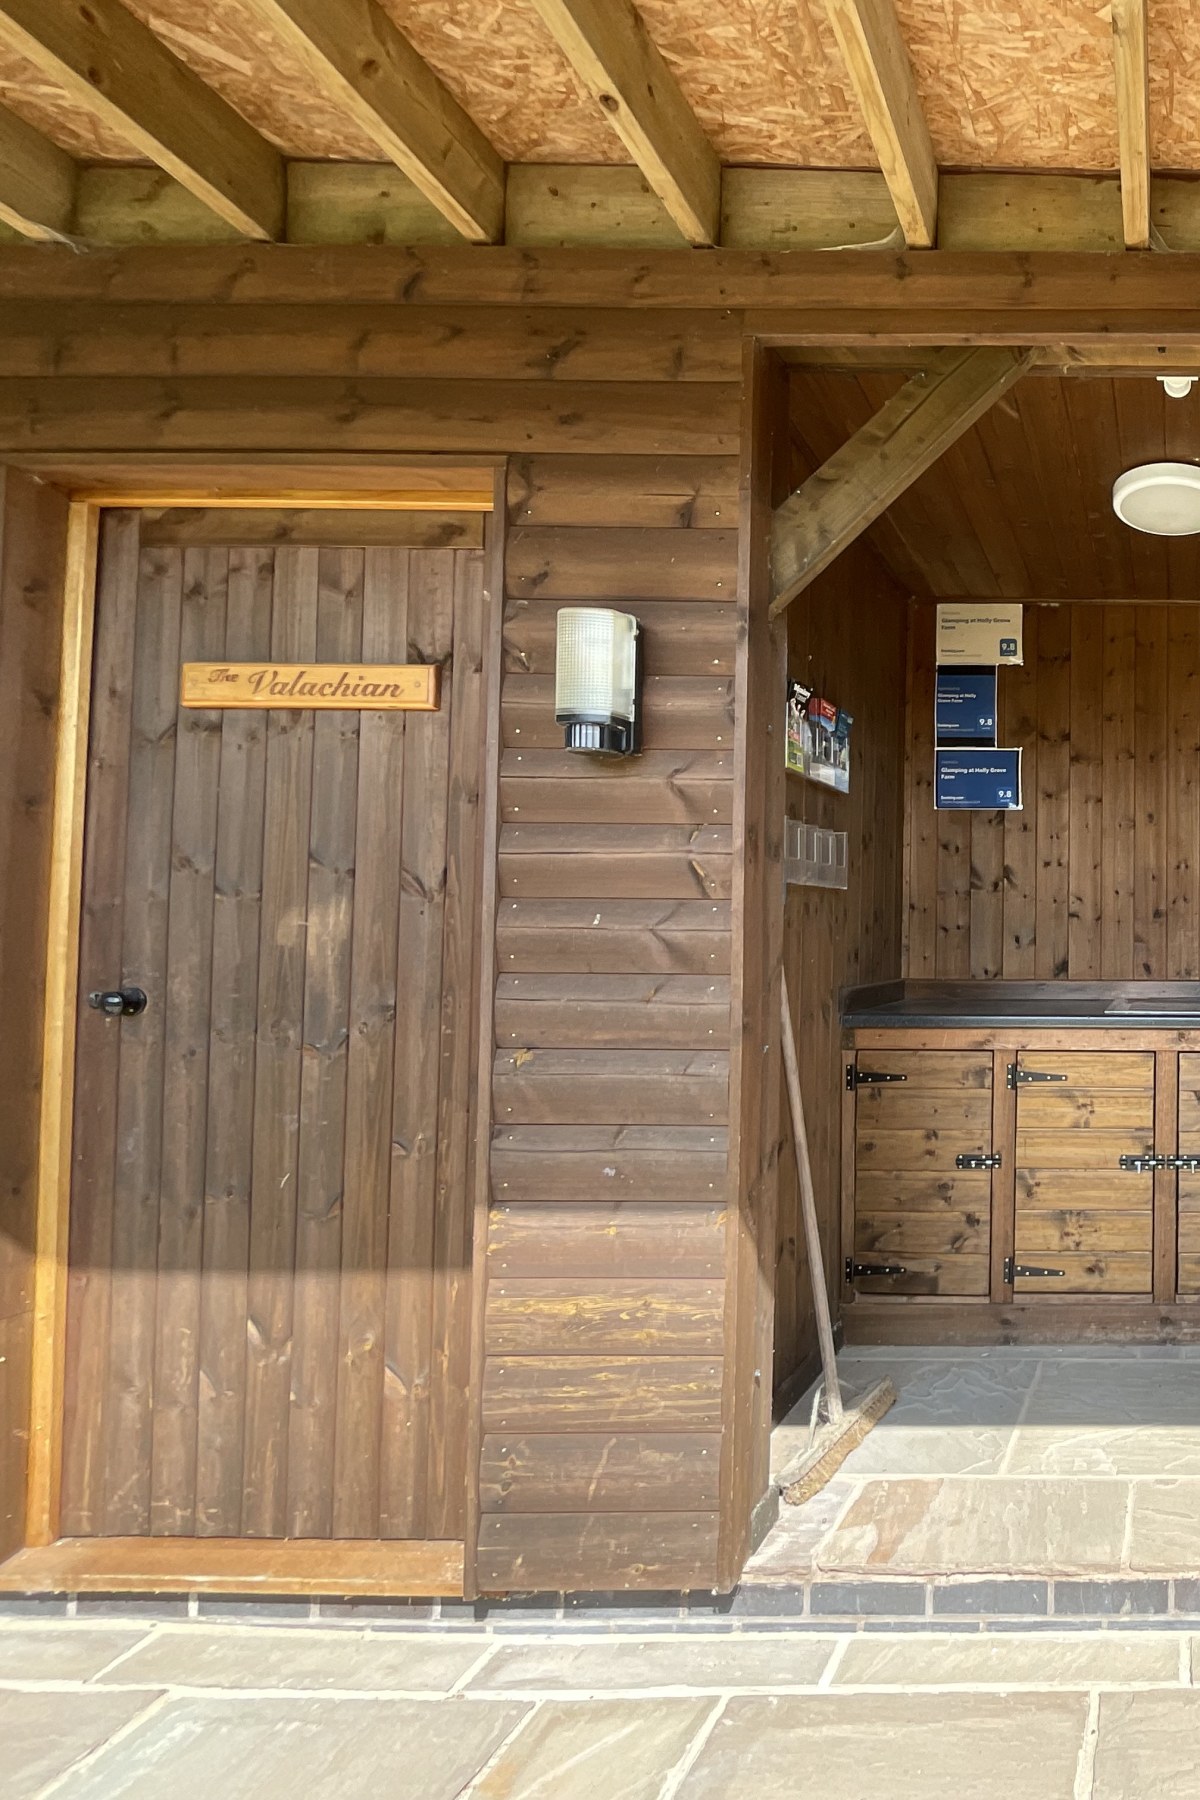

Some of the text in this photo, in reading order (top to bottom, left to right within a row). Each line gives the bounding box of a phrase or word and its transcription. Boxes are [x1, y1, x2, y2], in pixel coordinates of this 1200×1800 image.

[1001, 642, 1016, 651] 9.8
[207, 668, 404, 698] The Valachian
[979, 718, 993, 726] 9.8
[998, 790, 1012, 798] 9.8
